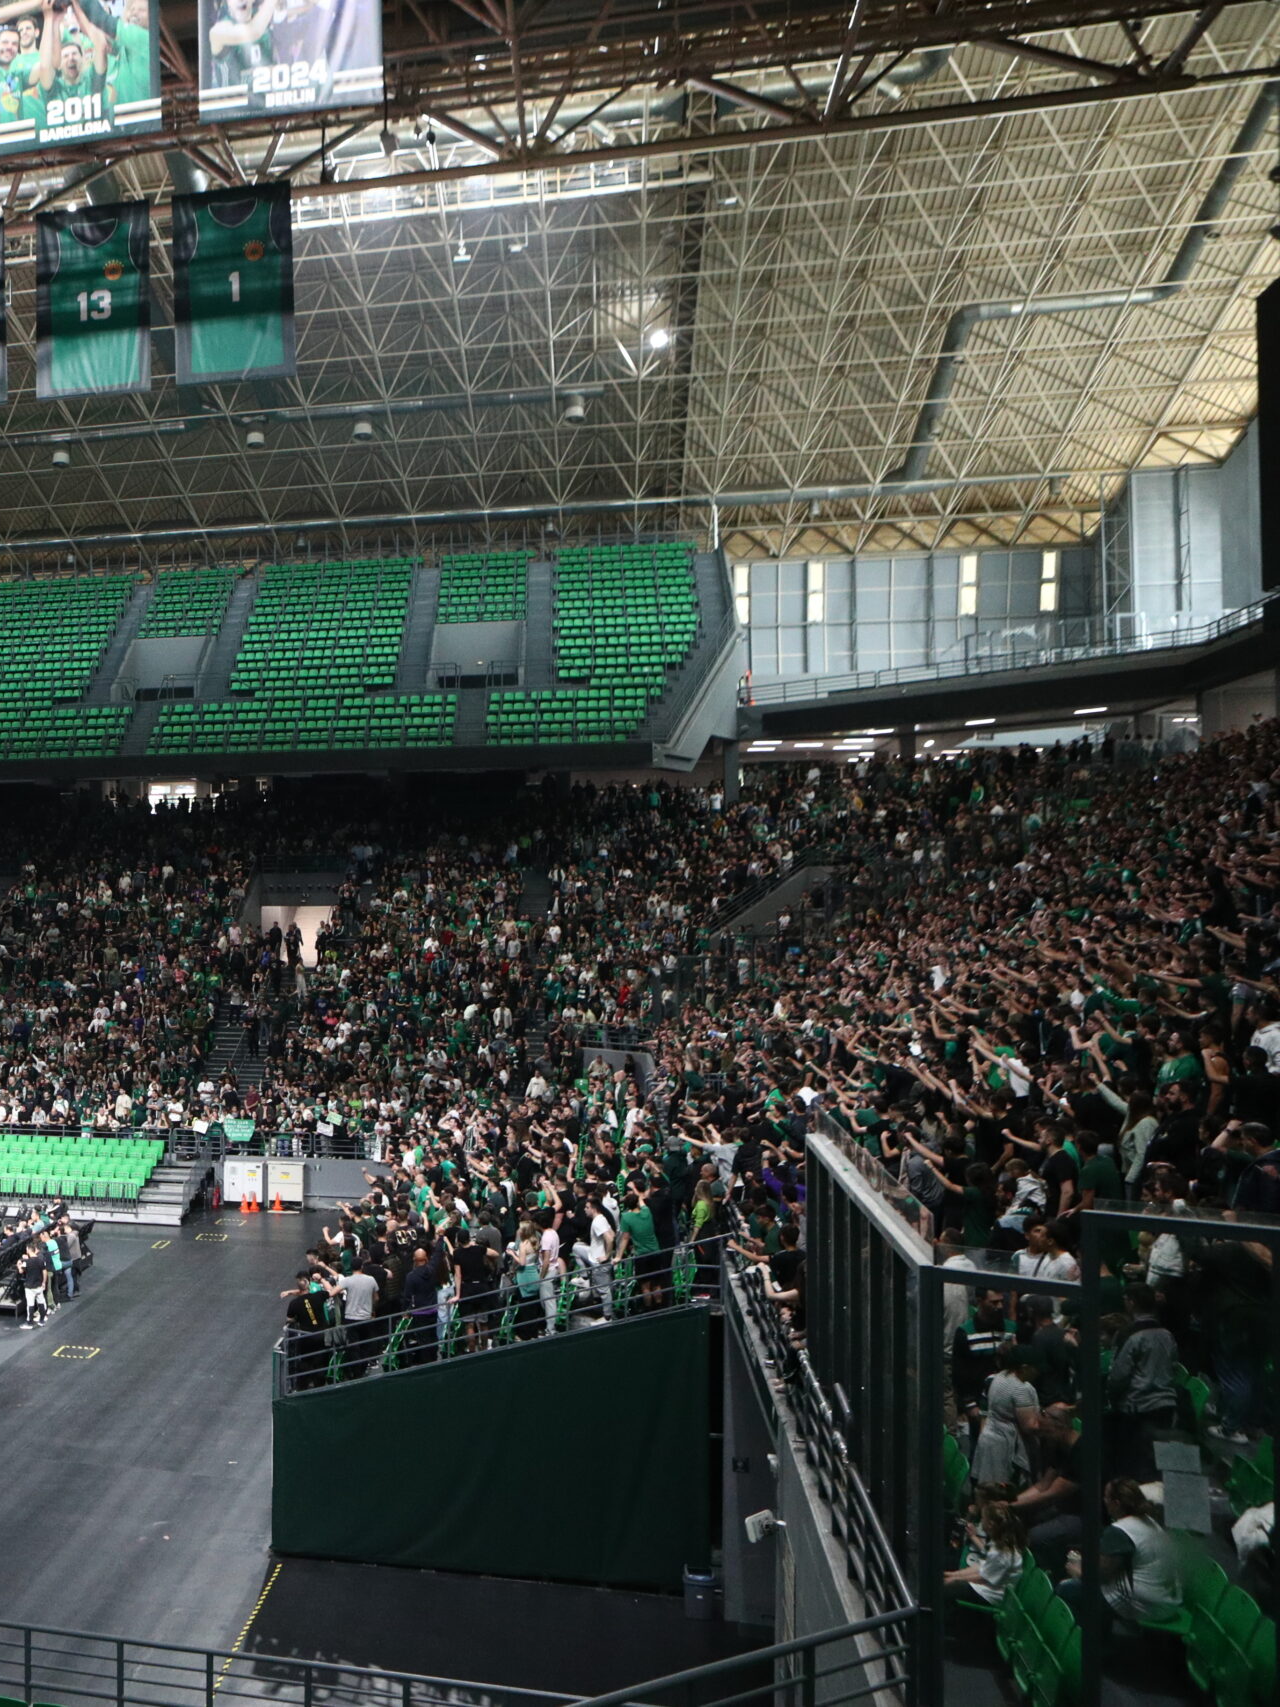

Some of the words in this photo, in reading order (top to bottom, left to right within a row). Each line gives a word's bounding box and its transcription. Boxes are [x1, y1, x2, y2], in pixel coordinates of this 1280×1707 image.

[252, 58, 328, 93] 2024
[46, 92, 102, 126] 2011
[265, 87, 316, 108] BERLIN
[40, 119, 112, 143] BARCELONA
[228, 271, 240, 302] 1
[76, 289, 112, 321] 13
